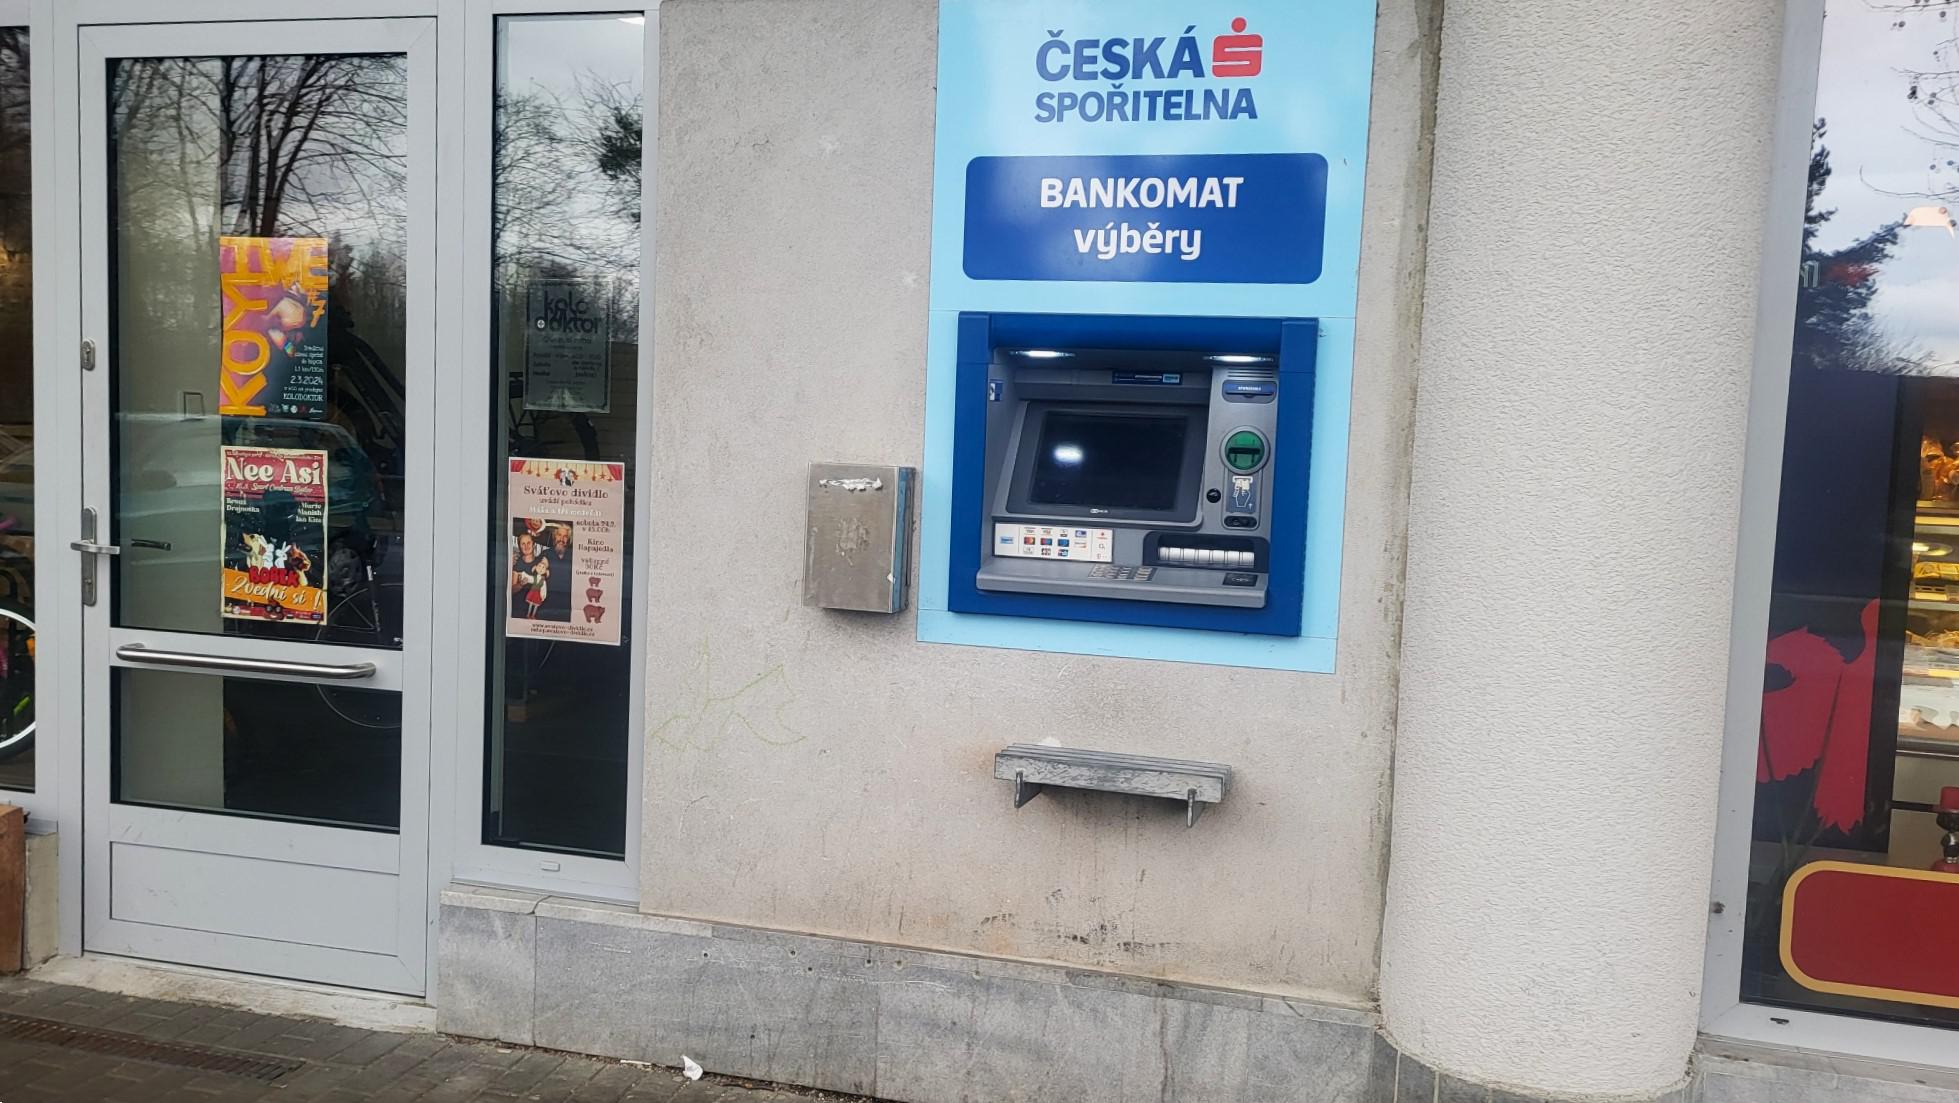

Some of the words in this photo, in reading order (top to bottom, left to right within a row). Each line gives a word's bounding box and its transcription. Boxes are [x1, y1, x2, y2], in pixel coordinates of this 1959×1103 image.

[1035, 25, 1206, 82] ČESKÁ
[1034, 82, 1259, 123] SPOŘITELNA
[1039, 176, 1245, 209] BANKOMAT
[1073, 222, 1202, 261] výběry
[544, 290, 590, 315] kolo
[283, 393, 324, 401] KOLODOKTOR
[227, 457, 274, 481] Nee
[281, 459, 321, 485] Asi
[523, 485, 568, 497] Sváťovo
[571, 487, 609, 499] dividlo
[578, 544, 614, 553] Napajedla
[293, 591, 306, 605] si
